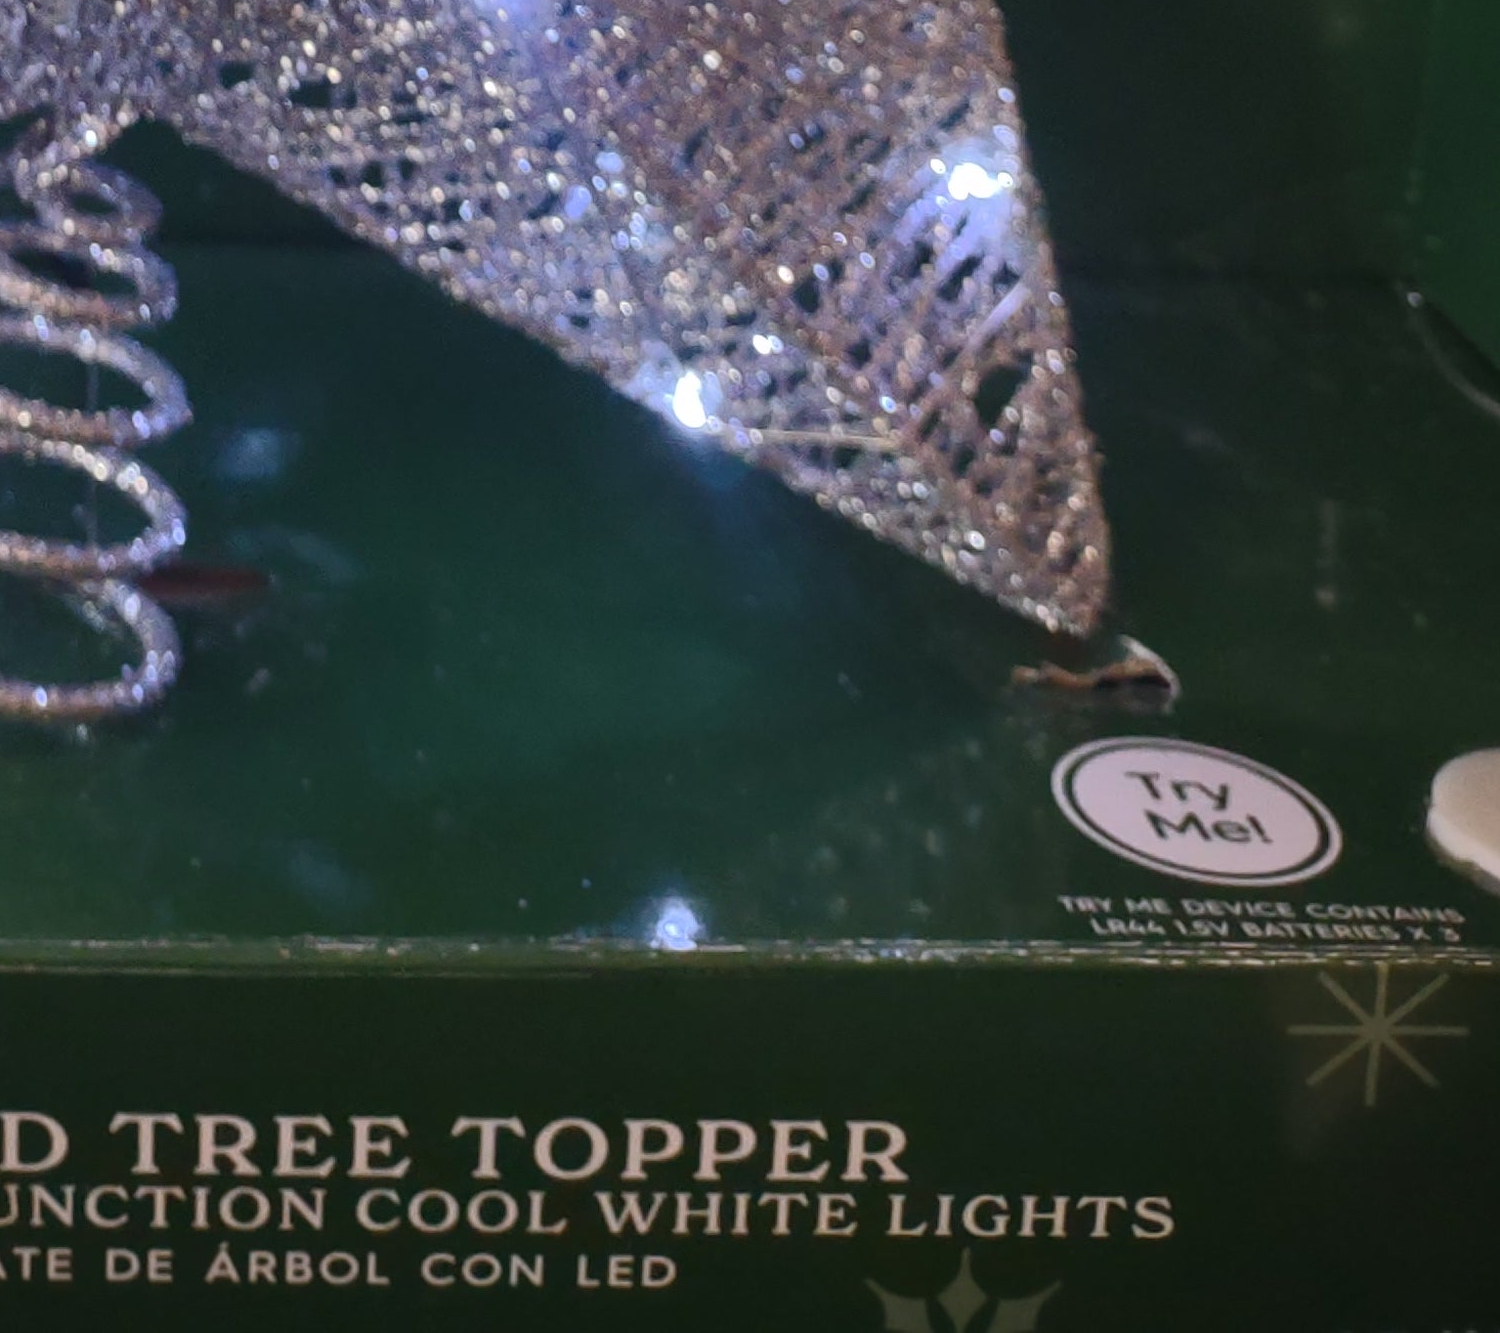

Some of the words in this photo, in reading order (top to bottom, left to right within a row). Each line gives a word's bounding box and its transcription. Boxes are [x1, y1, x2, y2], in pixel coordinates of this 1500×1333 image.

[1125, 771, 1230, 811] Try
[1143, 809, 1273, 844] Me!
[1124, 897, 1172, 915] ME
[1180, 899, 1296, 918] DEVICE
[1305, 903, 1466, 924] CONTAINS
[1240, 921, 1401, 942] BATTERIES
[109, 1111, 414, 1180] TREE
[451, 1117, 908, 1184] TOPPER
[355, 1188, 568, 1237] COOL
[593, 1190, 859, 1239] WHITE
[886, 1194, 1176, 1242] LIGHTS
[105, 1249, 177, 1283] DE
[205, 1241, 390, 1286] ÁRBOL
[420, 1254, 542, 1288] CON
[576, 1254, 678, 1290] LED
